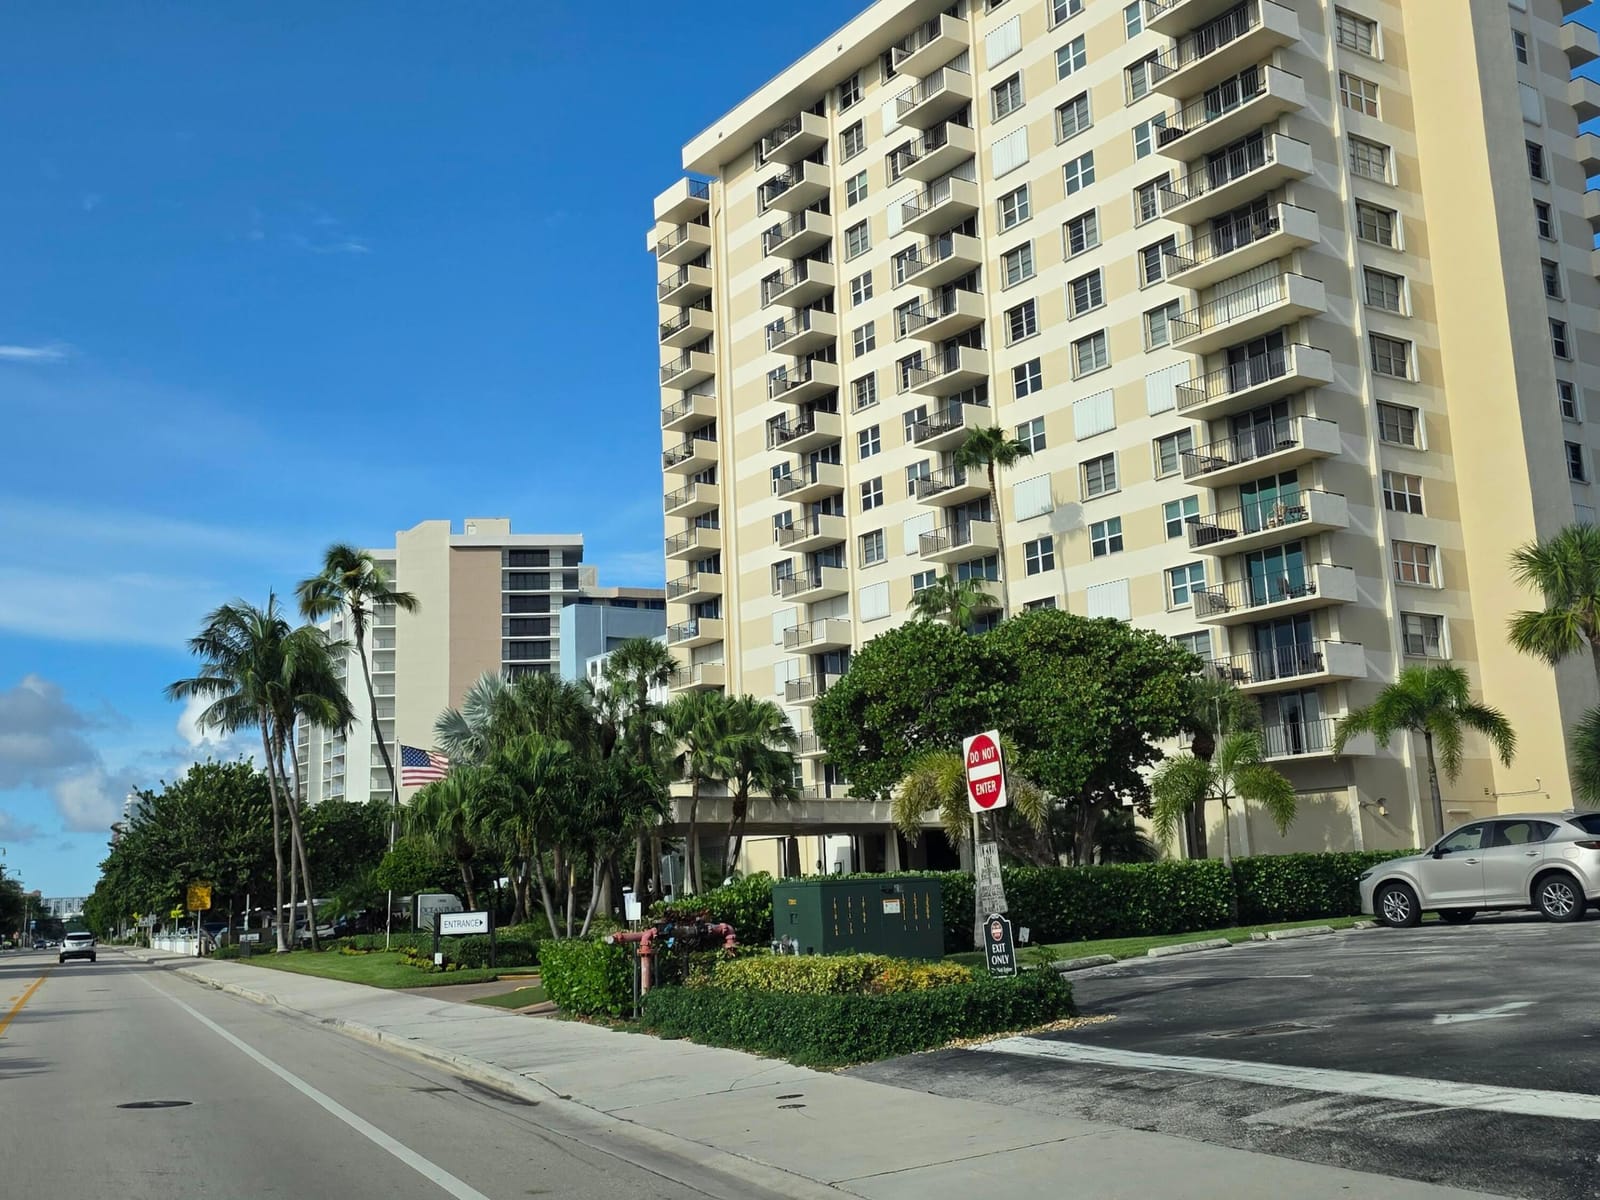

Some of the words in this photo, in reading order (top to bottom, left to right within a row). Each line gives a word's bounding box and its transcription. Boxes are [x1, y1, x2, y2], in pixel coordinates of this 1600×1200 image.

[970, 751, 980, 763] DO
[982, 747, 995, 760] NOT
[976, 780, 996, 796] ENTER
[444, 919, 479, 928] ENTRANCE
[991, 943, 1006, 954] EXIT
[991, 954, 1010, 966] ONLY
